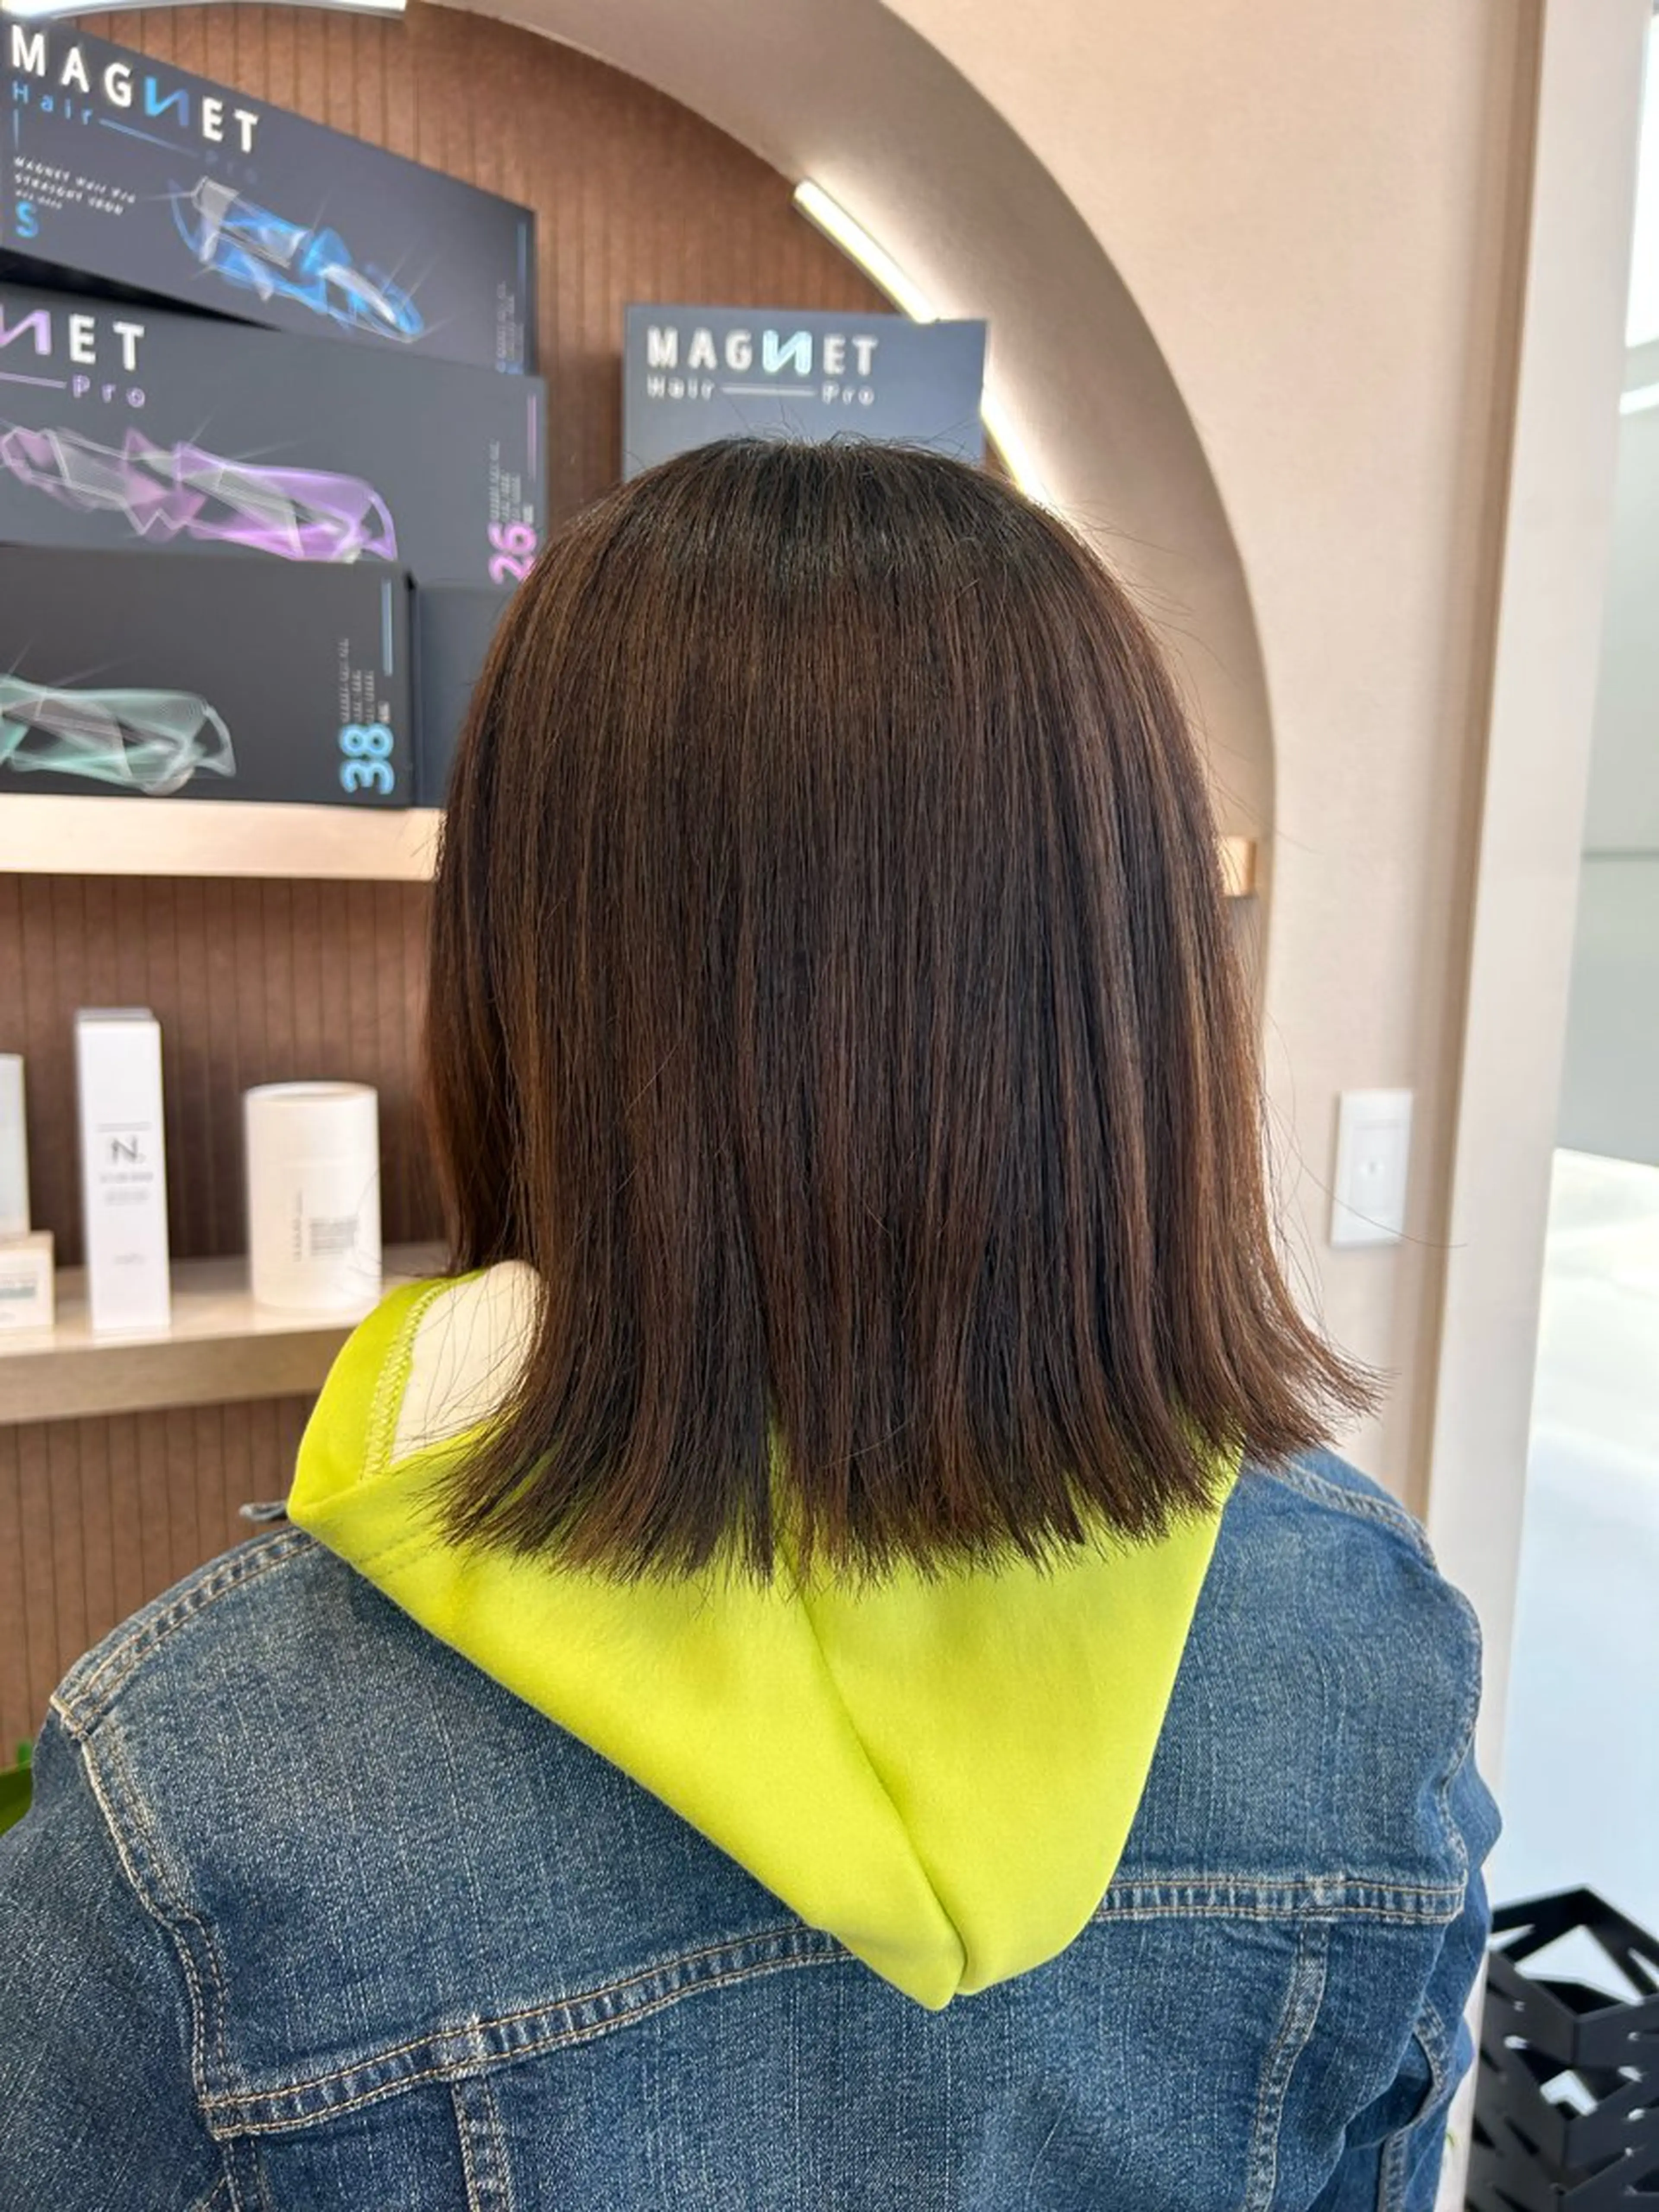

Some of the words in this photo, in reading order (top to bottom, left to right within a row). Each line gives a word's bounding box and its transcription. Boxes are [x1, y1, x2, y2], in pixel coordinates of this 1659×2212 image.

[12, 24, 259, 153] MAGNET
[13, 80, 92, 125] Hair
[14, 156, 70, 182] MAGNET
[15, 173, 83, 202] STRAIGHT
[15, 200, 39, 238] S
[647, 325, 879, 376] MAGNET
[72, 374, 146, 408] Pro
[647, 375, 715, 400] Hair
[821, 380, 875, 406] Pro
[488, 520, 537, 585] 26
[339, 724, 394, 795] 38
